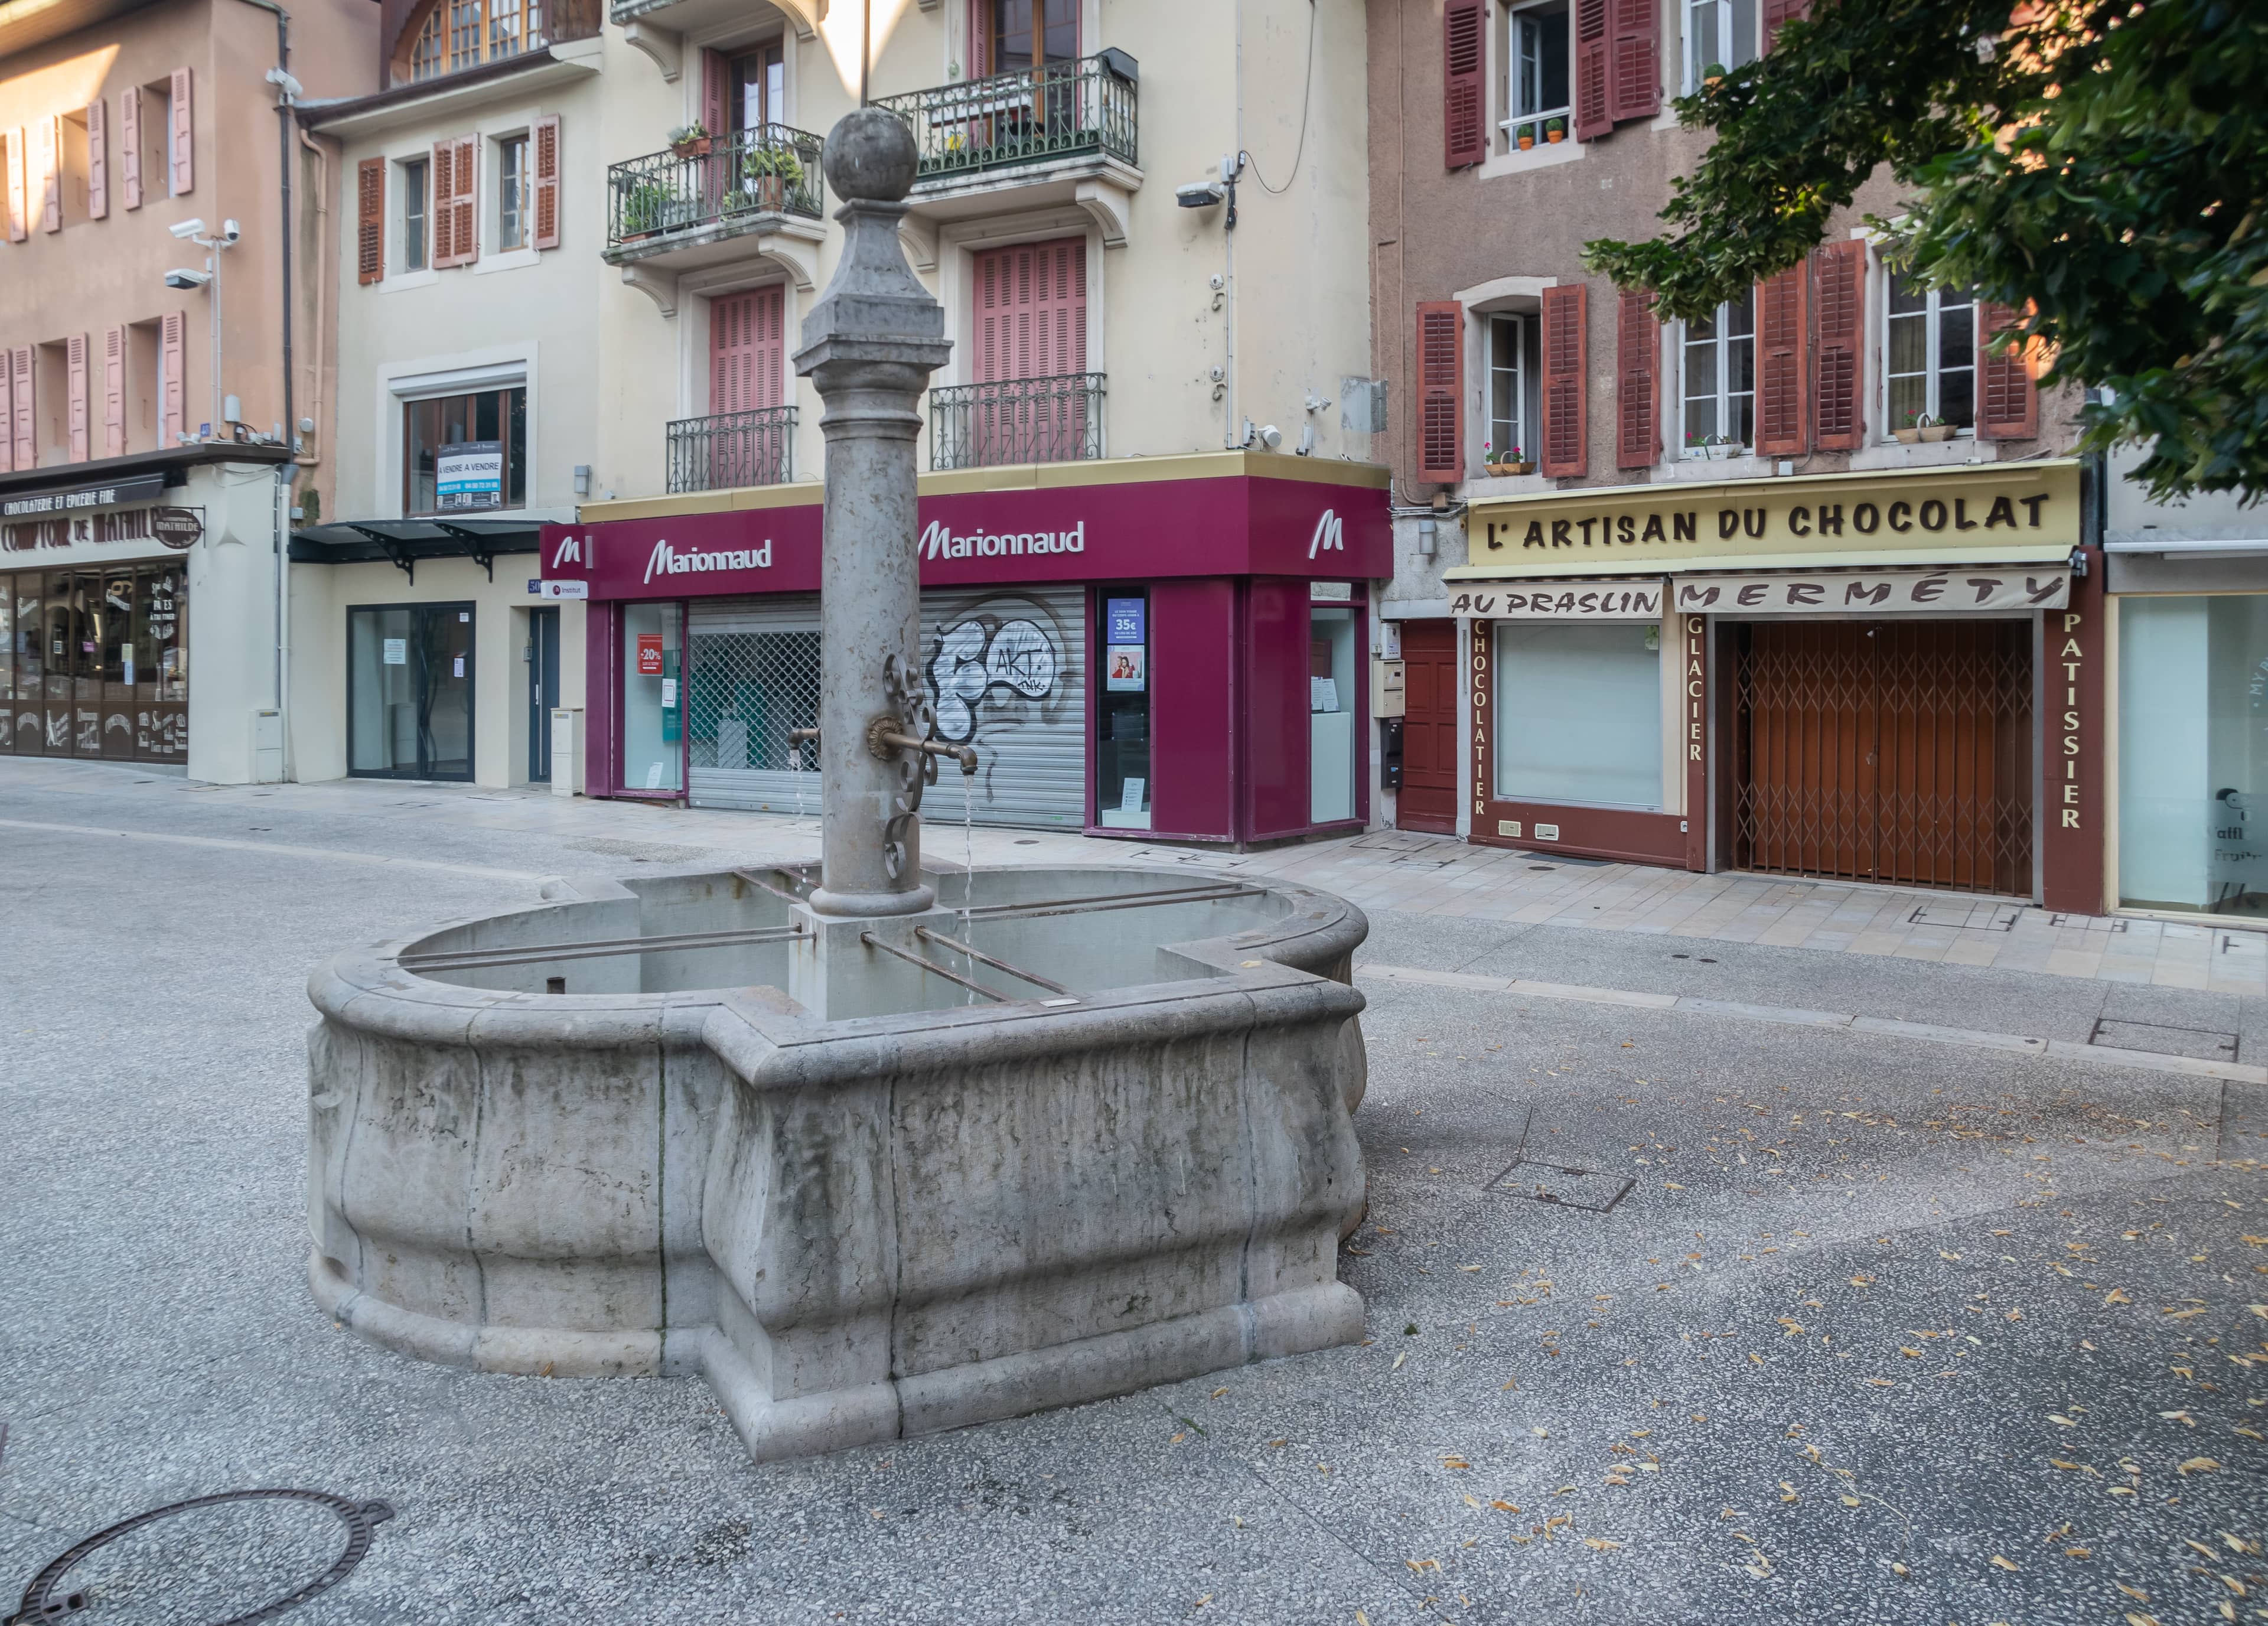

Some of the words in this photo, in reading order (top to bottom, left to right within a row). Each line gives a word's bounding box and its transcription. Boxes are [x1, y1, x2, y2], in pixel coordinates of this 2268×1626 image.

[443, 464, 462, 474] VENDRE
[464, 463, 470, 471] A
[471, 462, 500, 471] VENDRE
[4, 497, 53, 516] CHOCOLATERIE
[56, 496, 65, 509] ET
[67, 491, 97, 508] EPICERIE
[99, 489, 116, 504] FINE
[156, 521, 198, 532] MATHILDE
[1718, 508, 1767, 540] DU
[1788, 493, 2049, 536] CHOCOLAT
[74, 519, 89, 541] DE
[917, 520, 1084, 561] Marionnaud
[643, 539, 772, 584] Marionnaud
[530, 581, 540, 592] 50
[1679, 571, 2064, 607] MERMÉTY
[1451, 594, 1495, 614] AU
[1506, 591, 1659, 614] PRASLIN
[1116, 618, 1136, 630] 35€
[640, 648, 662, 660] -20%
[1687, 617, 1703, 761] GLACIER
[1473, 619, 1487, 815] CHOCOLATIER
[2061, 614, 2083, 829] PATISSIER
